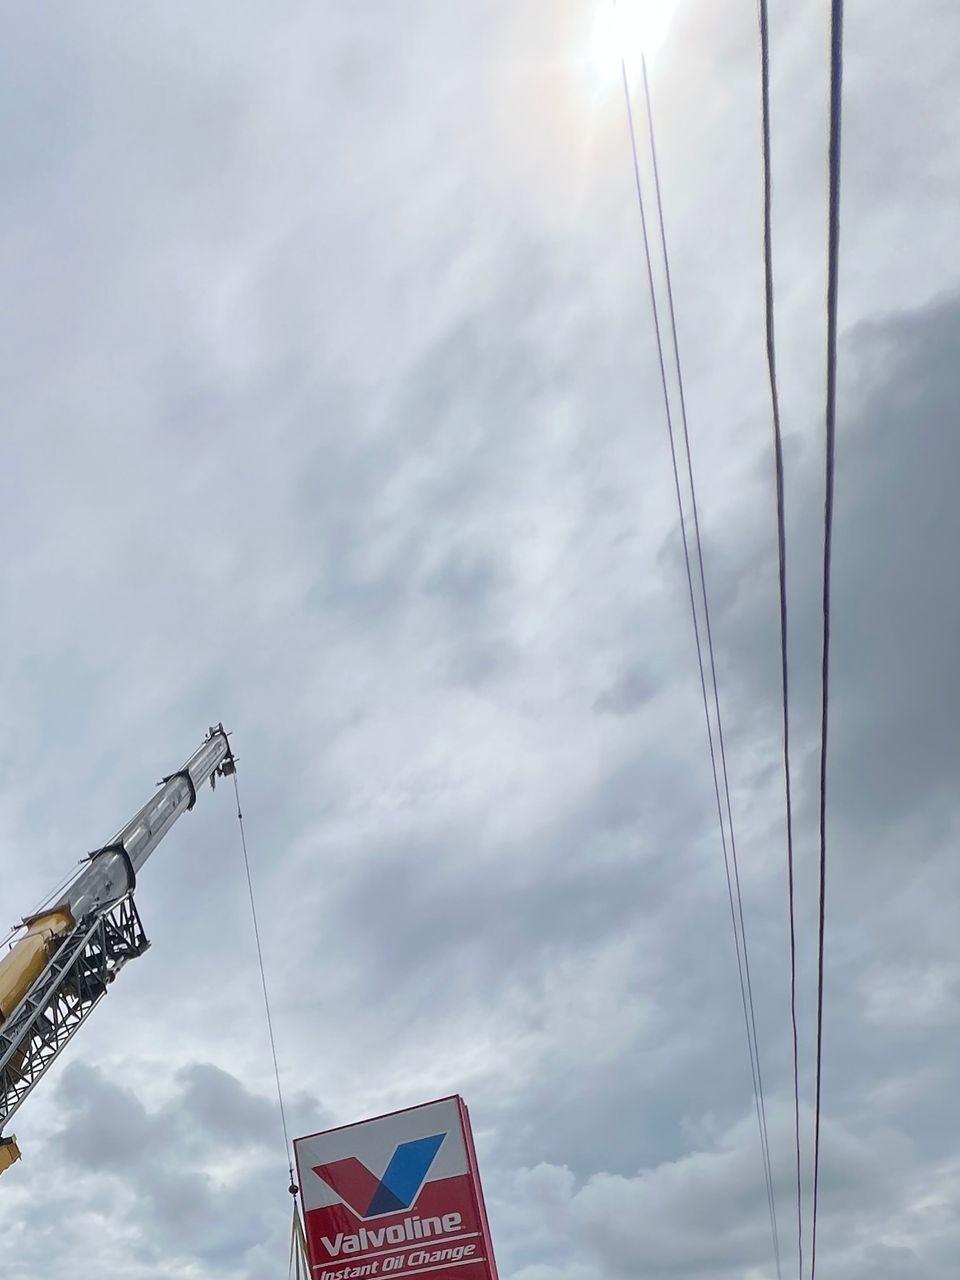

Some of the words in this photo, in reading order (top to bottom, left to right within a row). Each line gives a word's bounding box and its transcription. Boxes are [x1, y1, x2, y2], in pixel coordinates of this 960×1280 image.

[320, 1212, 462, 1257] Valvoline
[382, 1254, 404, 1272] Oil
[407, 1244, 476, 1267] Change
